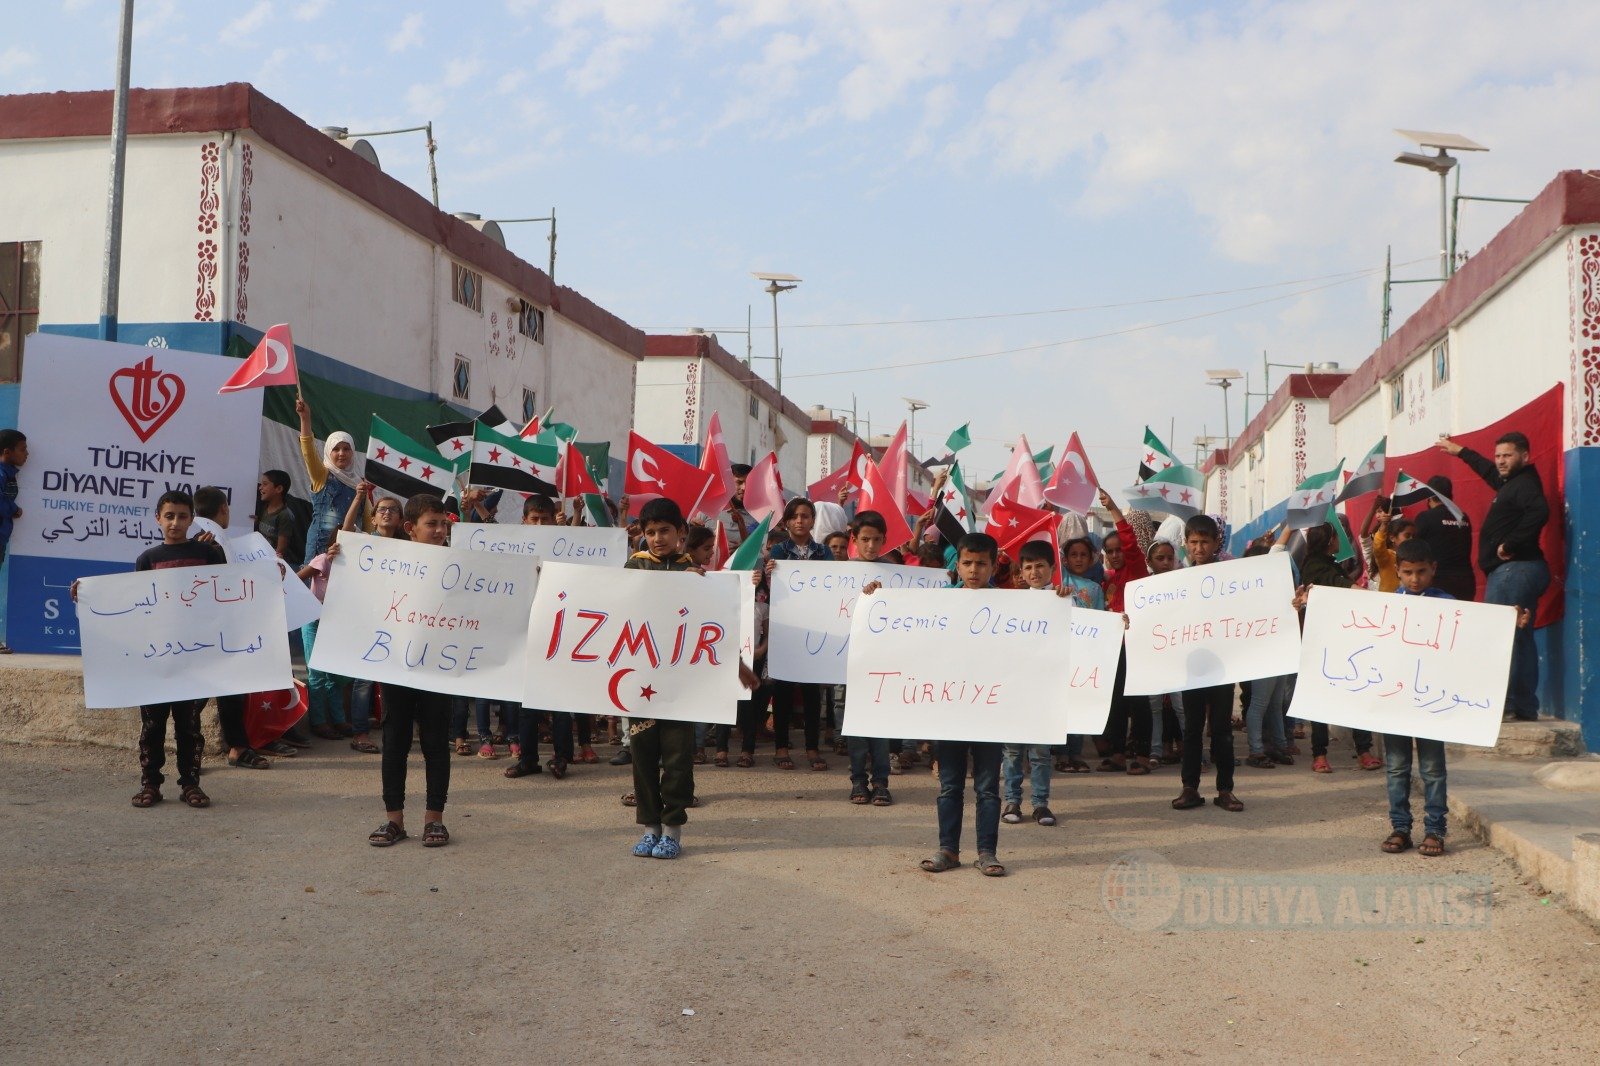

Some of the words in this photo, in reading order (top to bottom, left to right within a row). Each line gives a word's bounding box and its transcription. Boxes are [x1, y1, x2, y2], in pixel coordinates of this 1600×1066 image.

[88, 445, 196, 476] TÜRKİYE
[43, 468, 154, 499] DİYANET
[42, 498, 94, 513] TURKIYE
[98, 503, 150, 517] DIYANET
[41, 515, 110, 543] التركي
[552, 537, 607, 557] Olsun
[441, 563, 515, 596] Olsun
[1201, 575, 1264, 599] Olsun
[89, 582, 158, 615] ليس
[545, 590, 725, 669] İZMİR
[969, 606, 1048, 635] Olsun
[1152, 622, 1213, 651] SEHER
[1219, 616, 1279, 639] TEYZE
[1341, 603, 1396, 637] واحد
[143, 640, 215, 659] حدود
[219, 631, 263, 654] لها
[361, 630, 484, 671] BUSE
[868, 671, 1002, 705] TÜRKİYE
[1413, 658, 1490, 714] سوريا
